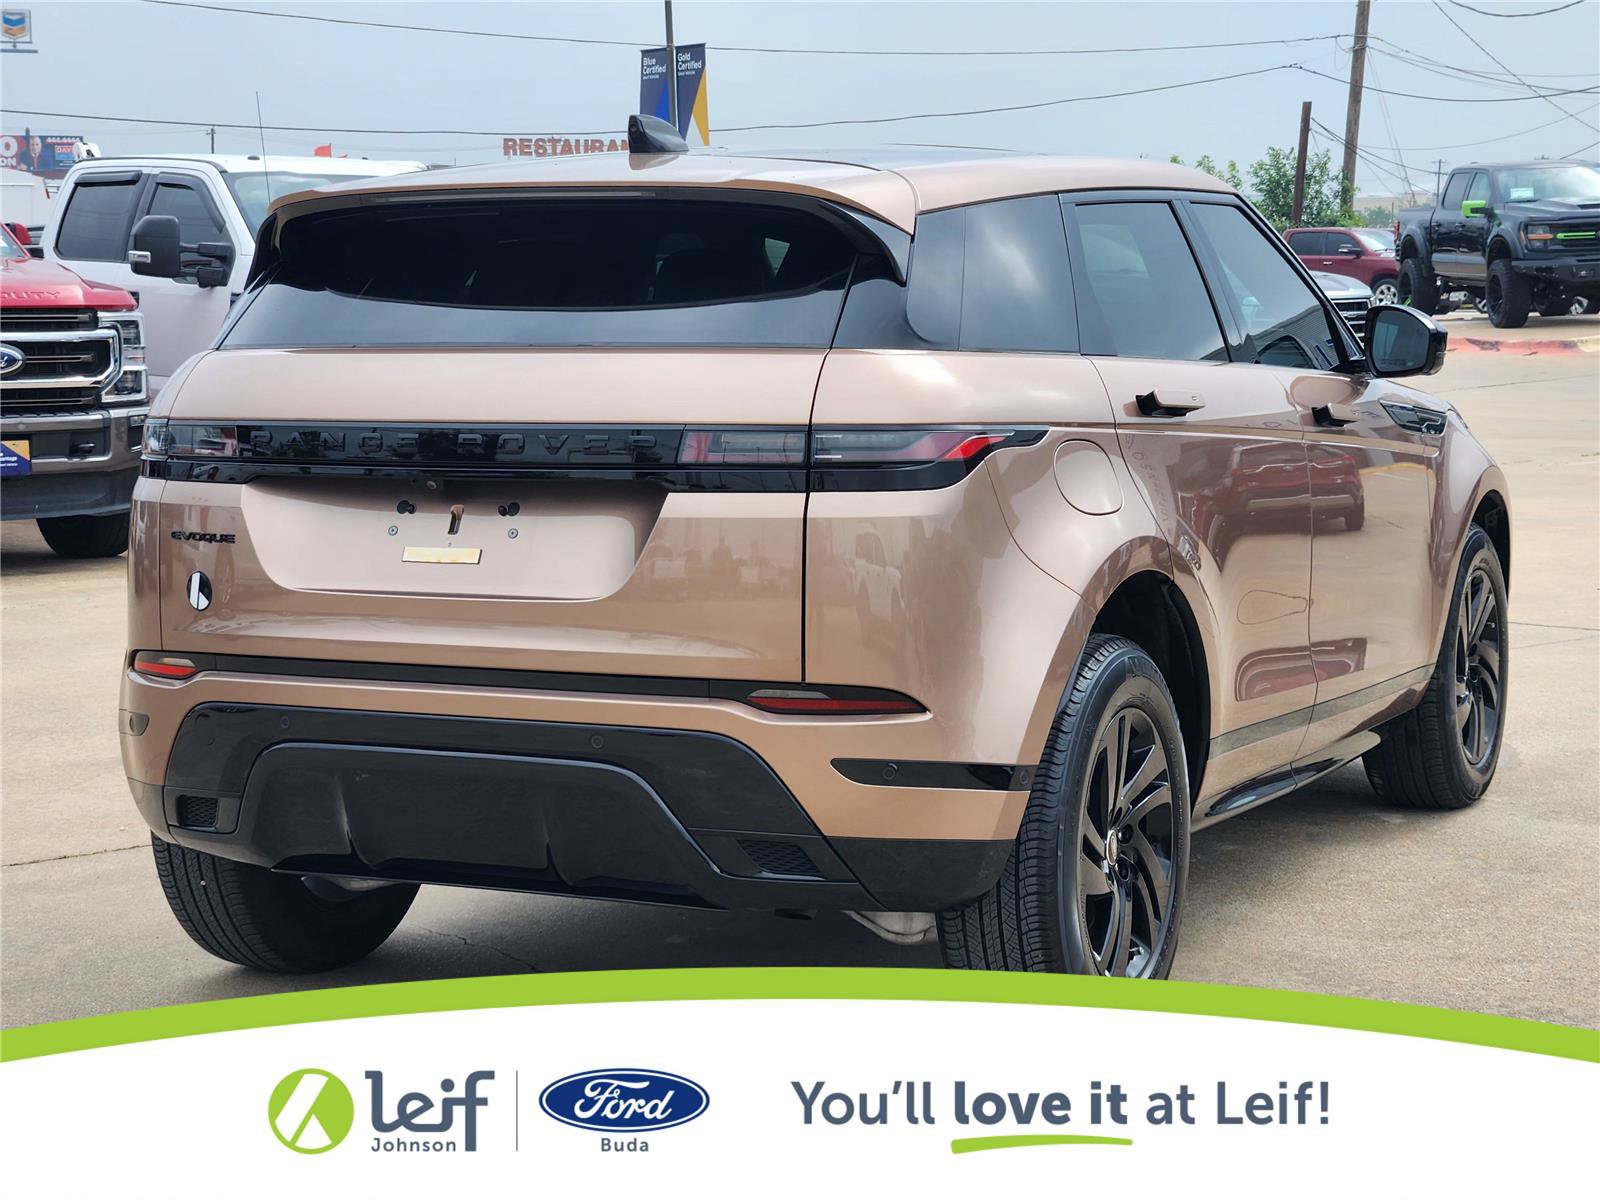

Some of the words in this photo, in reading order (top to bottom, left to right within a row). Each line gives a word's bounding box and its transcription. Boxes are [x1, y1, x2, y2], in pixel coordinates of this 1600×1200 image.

[642, 57, 657, 66] Blue
[677, 52, 691, 62] Gold
[642, 64, 667, 75] Certified
[677, 60, 702, 71] Certified
[250, 431, 420, 455] RANGE
[457, 433, 658, 456] ROVER
[171, 531, 236, 544] EVOQUE
